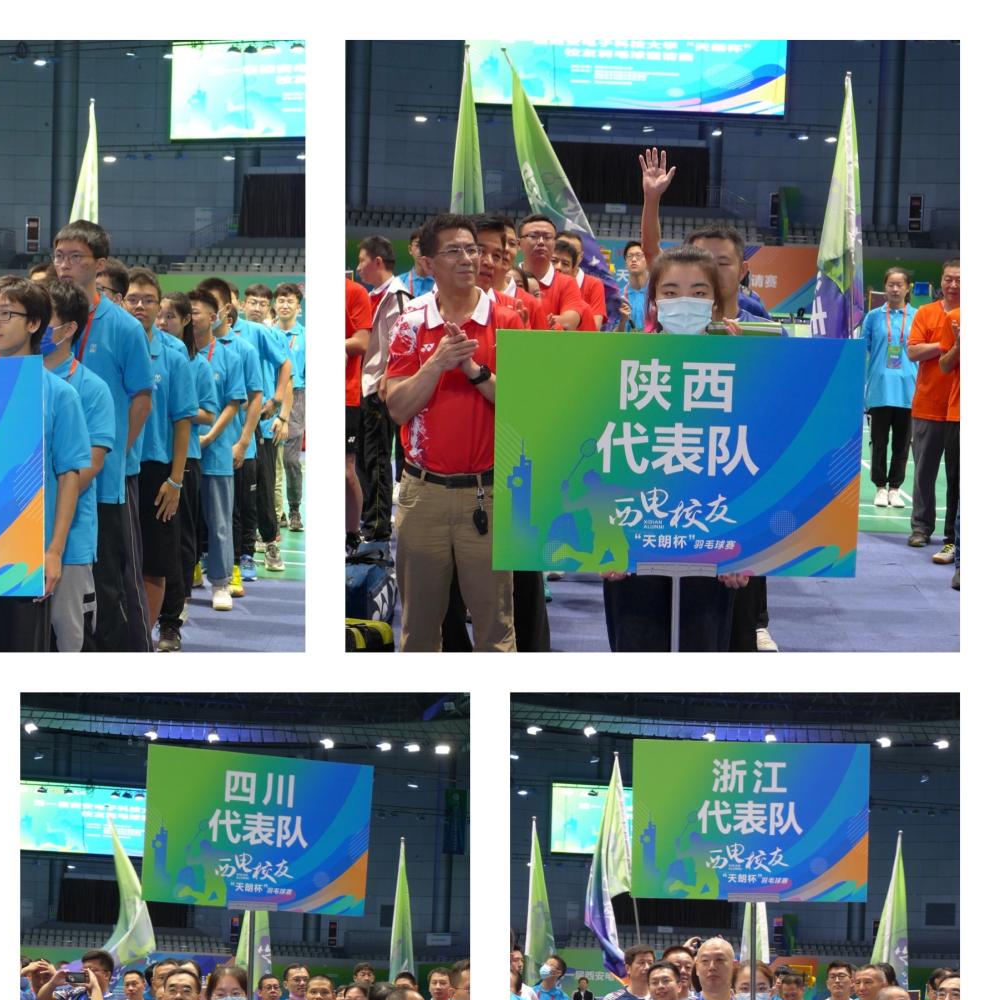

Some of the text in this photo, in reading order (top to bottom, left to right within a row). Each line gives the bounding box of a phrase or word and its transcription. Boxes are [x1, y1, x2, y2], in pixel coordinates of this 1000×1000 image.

[620, 358, 736, 413] 陕西
[596, 421, 760, 477] 代表队
[609, 487, 738, 532] 西电校友
[224, 770, 296, 808] 四川
[712, 758, 787, 793] 浙江
[208, 808, 308, 849] 代表队
[697, 800, 803, 835] 代表队
[215, 852, 294, 884] 西电校友
[706, 842, 789, 873] 西电校友
